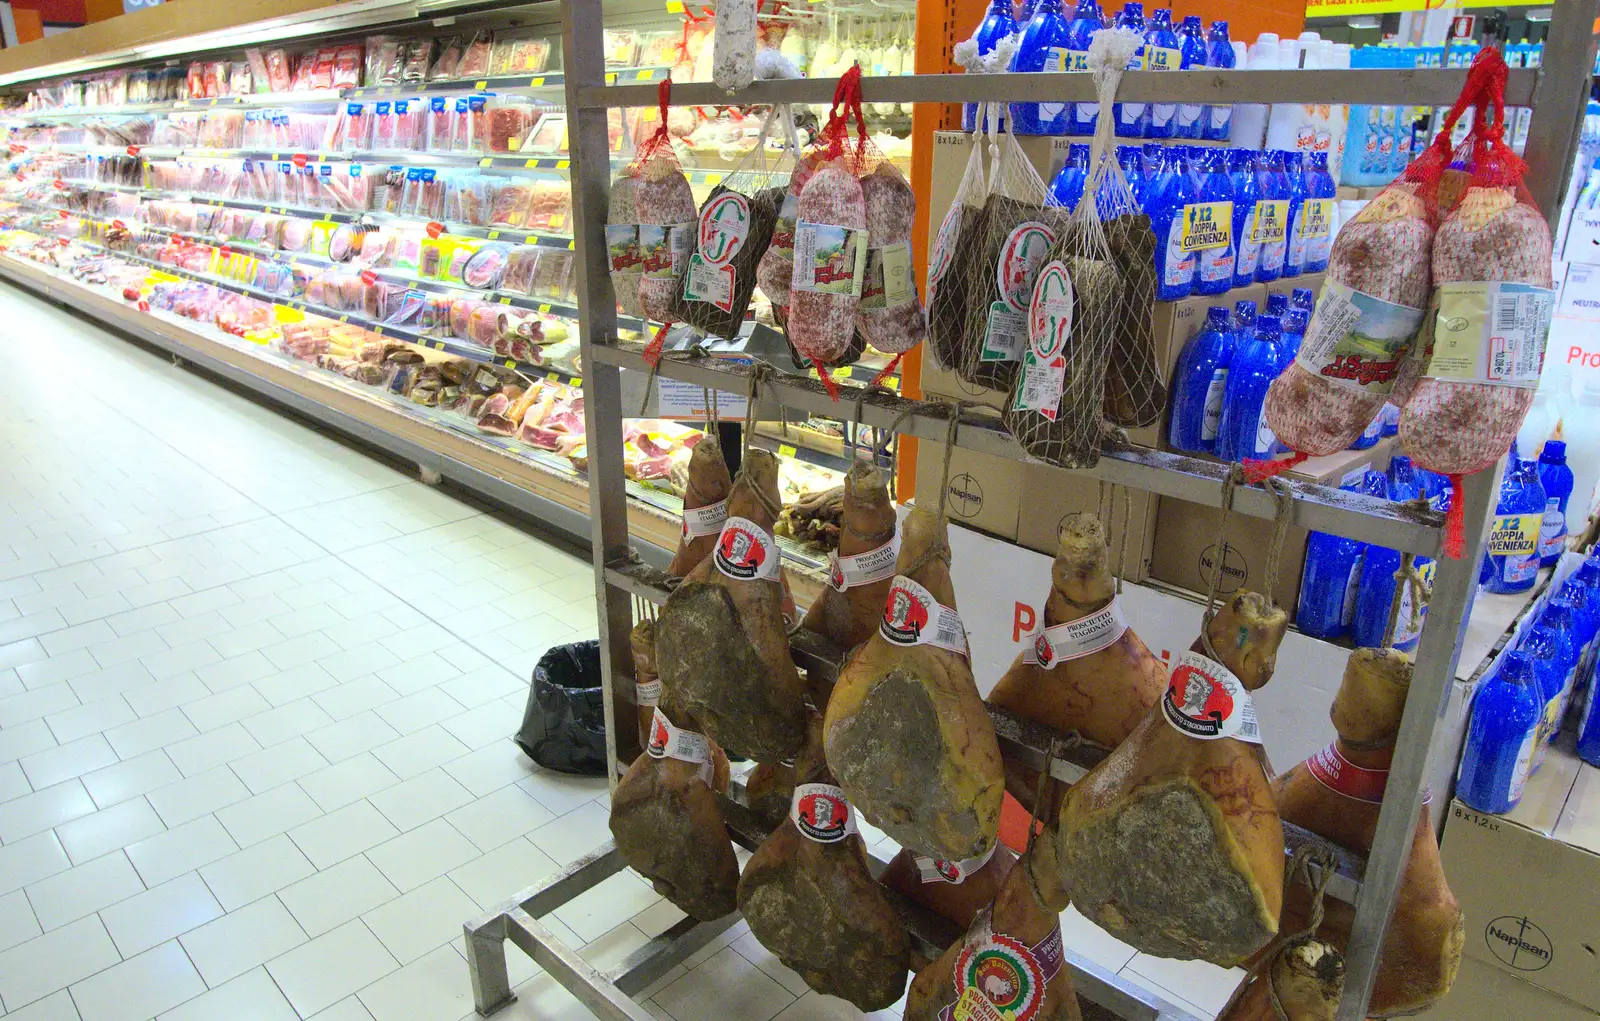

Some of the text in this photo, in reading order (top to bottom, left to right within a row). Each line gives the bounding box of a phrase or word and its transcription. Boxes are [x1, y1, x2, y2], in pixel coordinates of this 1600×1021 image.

[1199, 206, 1213, 222] X2
[1194, 221, 1217, 234] DOPPIA
[1184, 231, 1228, 247] CONVENIENZA
[950, 486, 982, 504] Napisan
[1500, 518, 1520, 530] X2
[1491, 531, 1524, 541] DOPPIA
[855, 546, 892, 564] PROSCIUTTO
[857, 552, 895, 569] STAGIONATO
[1067, 611, 1111, 632] PROSCIUTTO
[1070, 617, 1114, 640] STAGIONATO
[1455, 808, 1462, 818] 8
[1463, 812, 1471, 821] x
[1473, 815, 1489, 828] 1,2
[1488, 924, 1550, 961] Napisan
